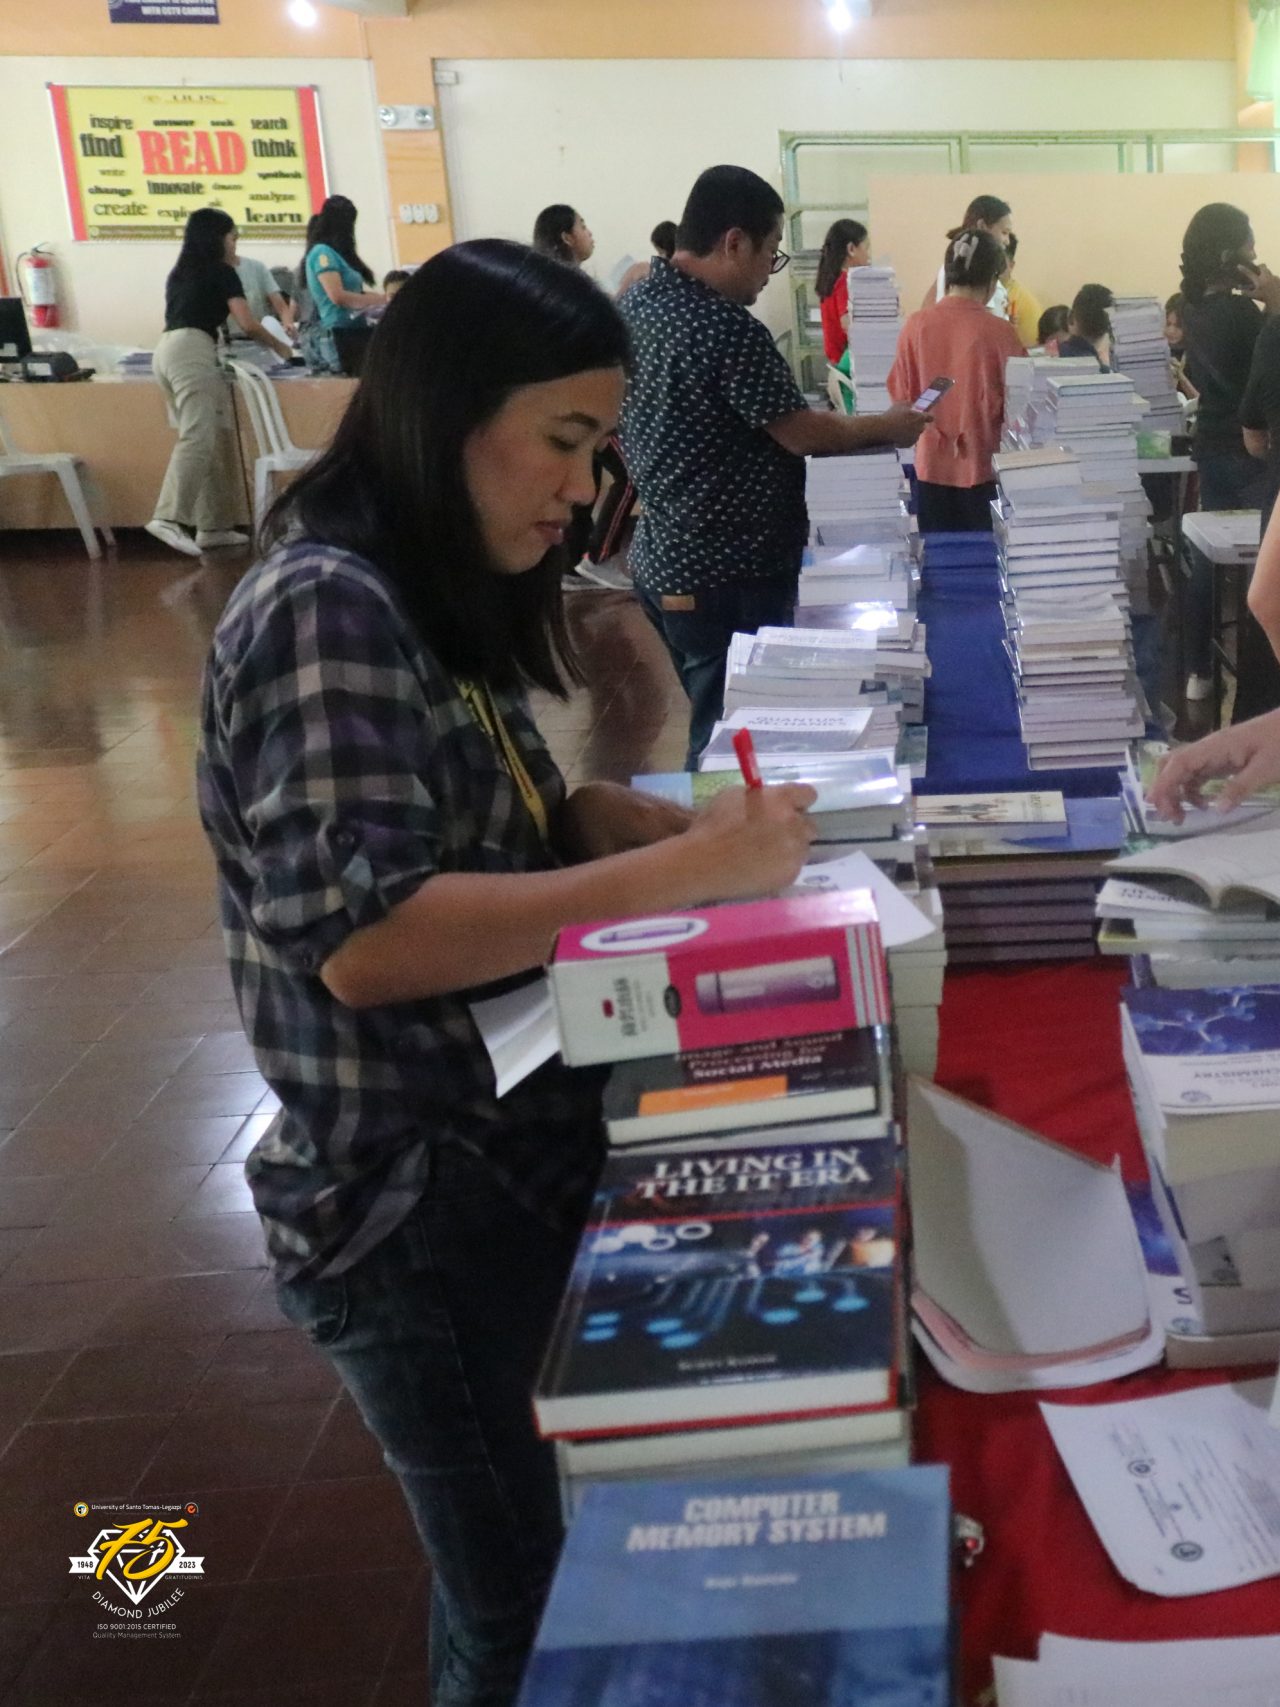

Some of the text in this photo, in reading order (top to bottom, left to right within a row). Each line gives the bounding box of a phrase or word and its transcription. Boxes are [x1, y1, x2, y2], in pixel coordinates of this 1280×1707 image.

[89, 113, 133, 132] inspire
[250, 116, 288, 130] search
[80, 133, 124, 158] find
[137, 130, 247, 175] READ
[252, 138, 298, 157] think
[88, 185, 133, 197] change
[147, 180, 205, 195] innovate
[248, 191, 296, 203] analyze
[94, 202, 148, 216] create
[245, 207, 303, 222] learn
[692, 1063, 754, 1079] Social
[760, 1055, 823, 1072] Media
[655, 1147, 861, 1179] LIVING IN
[636, 1164, 872, 1199] THE IT ERA
[684, 1490, 841, 1524] COMPUTER
[626, 1512, 887, 1554] MEMORY SYSTEM
